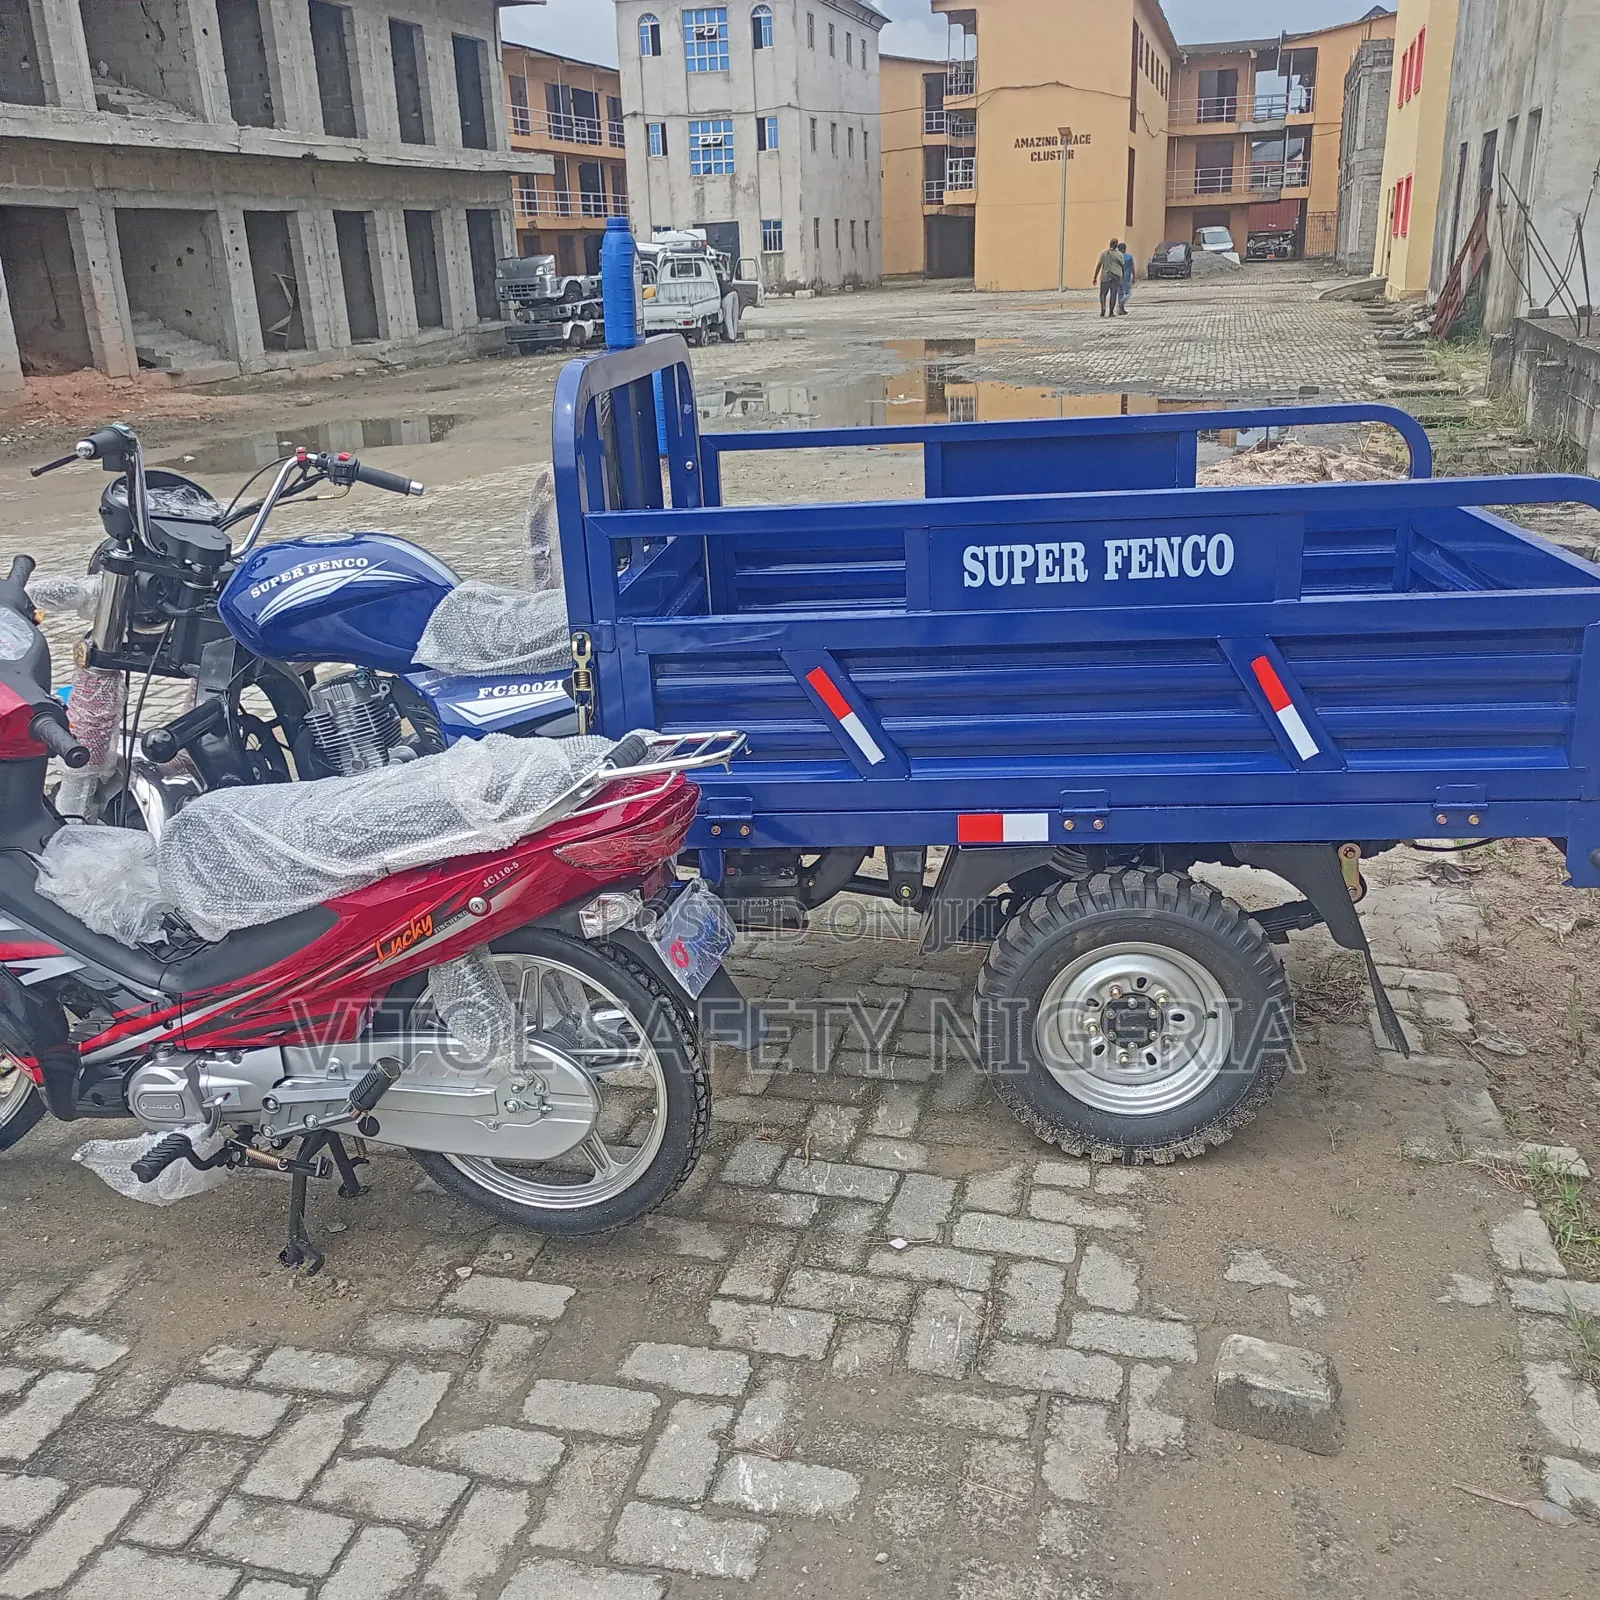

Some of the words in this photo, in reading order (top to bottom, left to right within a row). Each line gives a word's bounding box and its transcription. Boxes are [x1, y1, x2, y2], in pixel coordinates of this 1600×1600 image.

[1014, 136, 1058, 149] AMAZING
[1030, 150, 1074, 162] CLUSTR
[963, 541, 1089, 588] SUPER
[1104, 533, 1235, 581] FENCO
[250, 565, 305, 599] SUPER
[307, 557, 368, 574] FENCO
[483, 861, 519, 888] JC110-5
[434, 909, 469, 934] JINCHENG
[375, 915, 433, 964] Lucky
